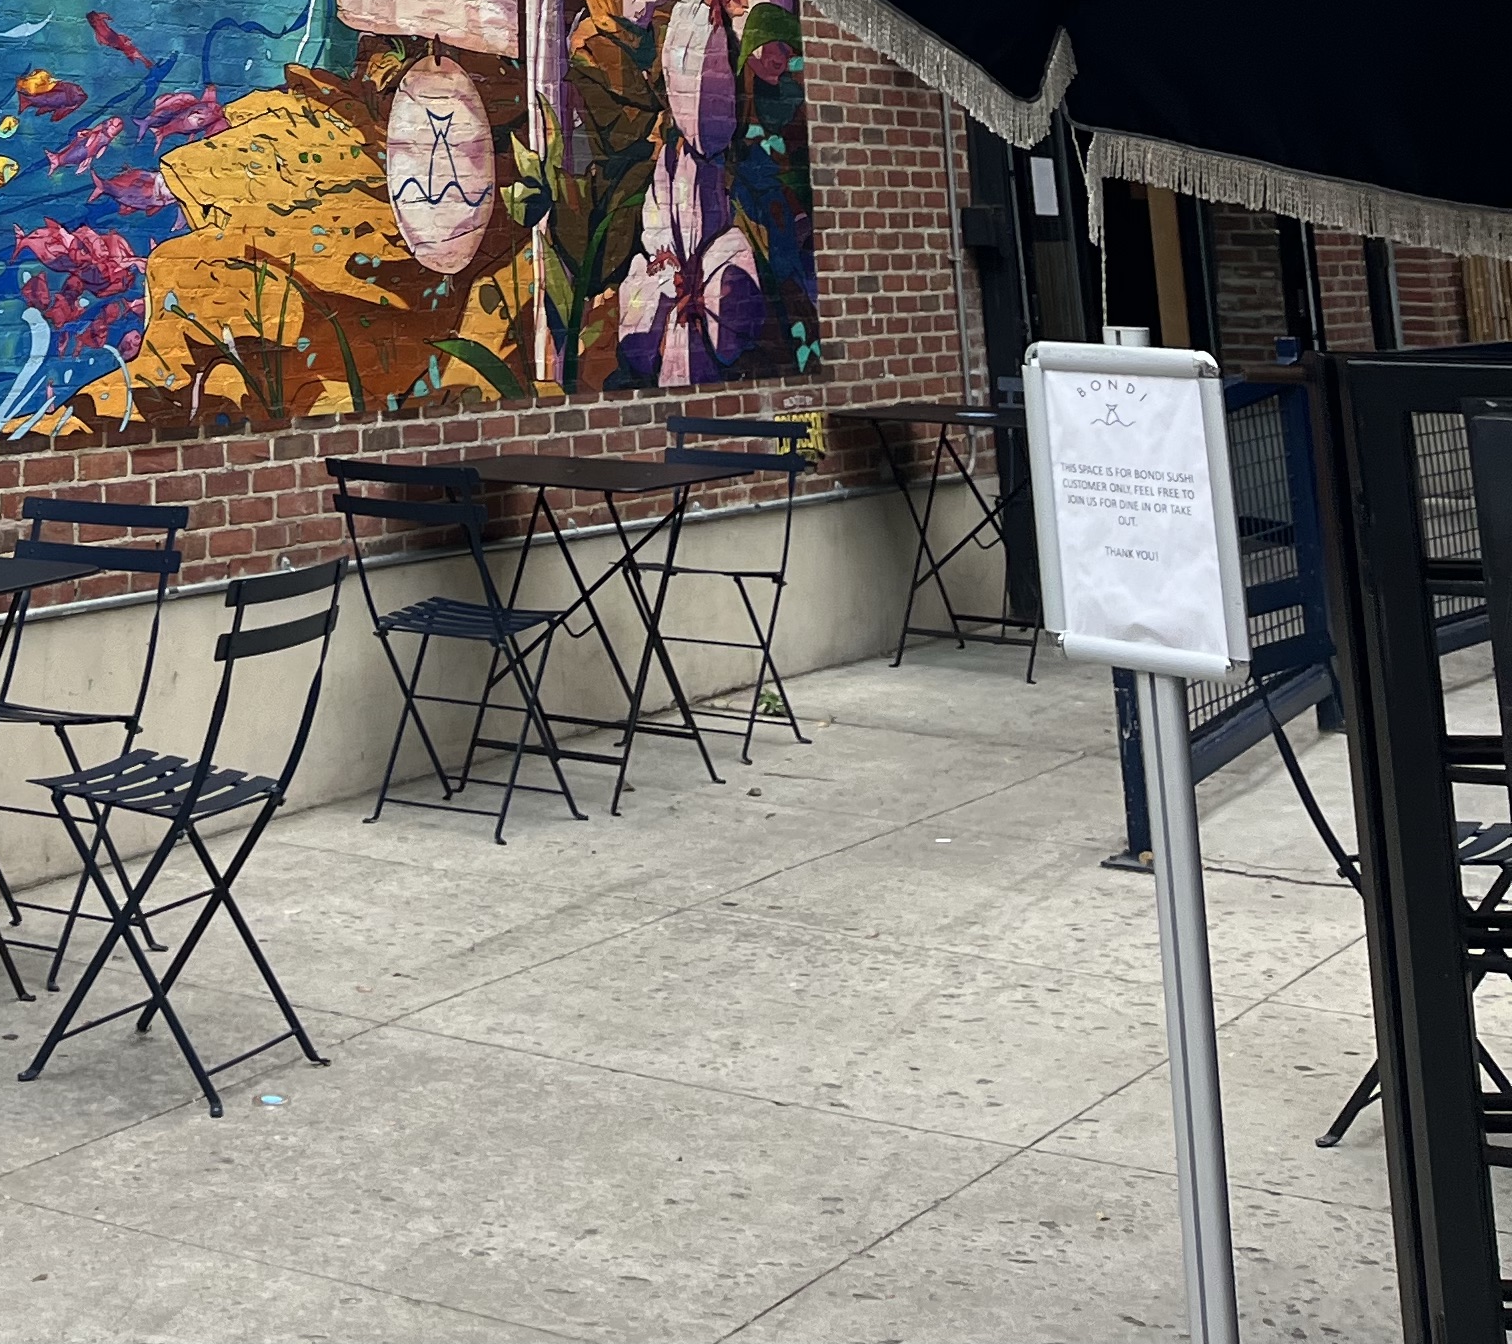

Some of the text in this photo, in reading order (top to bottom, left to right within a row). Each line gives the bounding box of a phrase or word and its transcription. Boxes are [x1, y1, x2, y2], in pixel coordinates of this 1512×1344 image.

[1076, 379, 1148, 402] BONDI
[1061, 462, 1193, 483] THIS SPACE IS FOR BONDI SUSHI
[1063, 478, 1106, 491] CUSTOMER
[1134, 485, 1154, 496] FEEL
[1158, 488, 1179, 498] FREE
[1183, 489, 1194, 500] TO
[1068, 495, 1192, 516] JOIN US FOR DINE IN OR TAKE
[1118, 516, 1137, 526] OUT.
[1105, 546, 1159, 561] THANK YOU!
